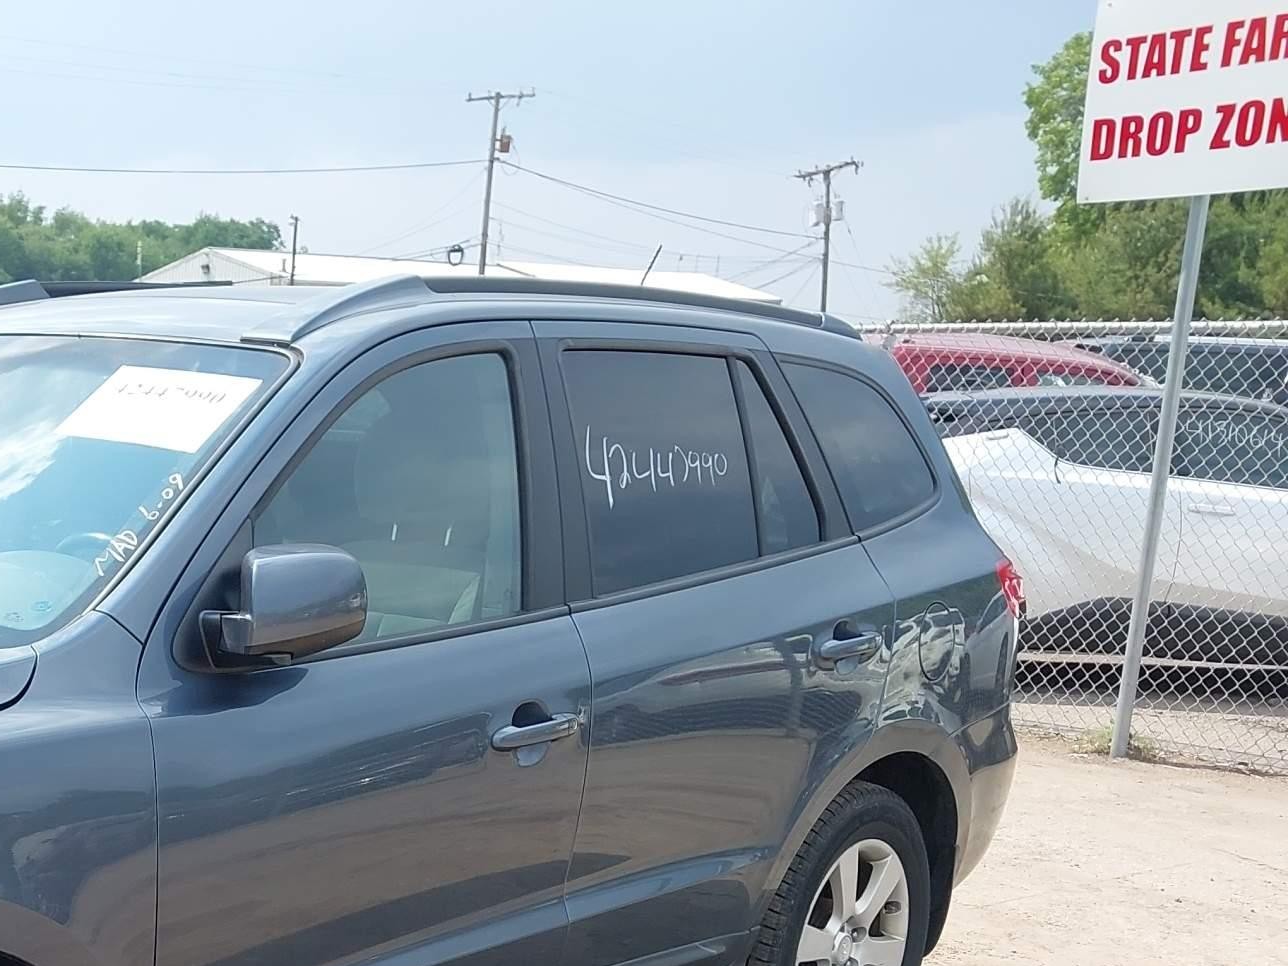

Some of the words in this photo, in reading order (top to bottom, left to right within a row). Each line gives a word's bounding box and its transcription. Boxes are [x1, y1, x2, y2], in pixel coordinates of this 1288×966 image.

[1098, 25, 1214, 84] STATE
[1090, 108, 1203, 161] DROP
[586, 425, 728, 510] 42447990
[95, 530, 138, 576] MAD
